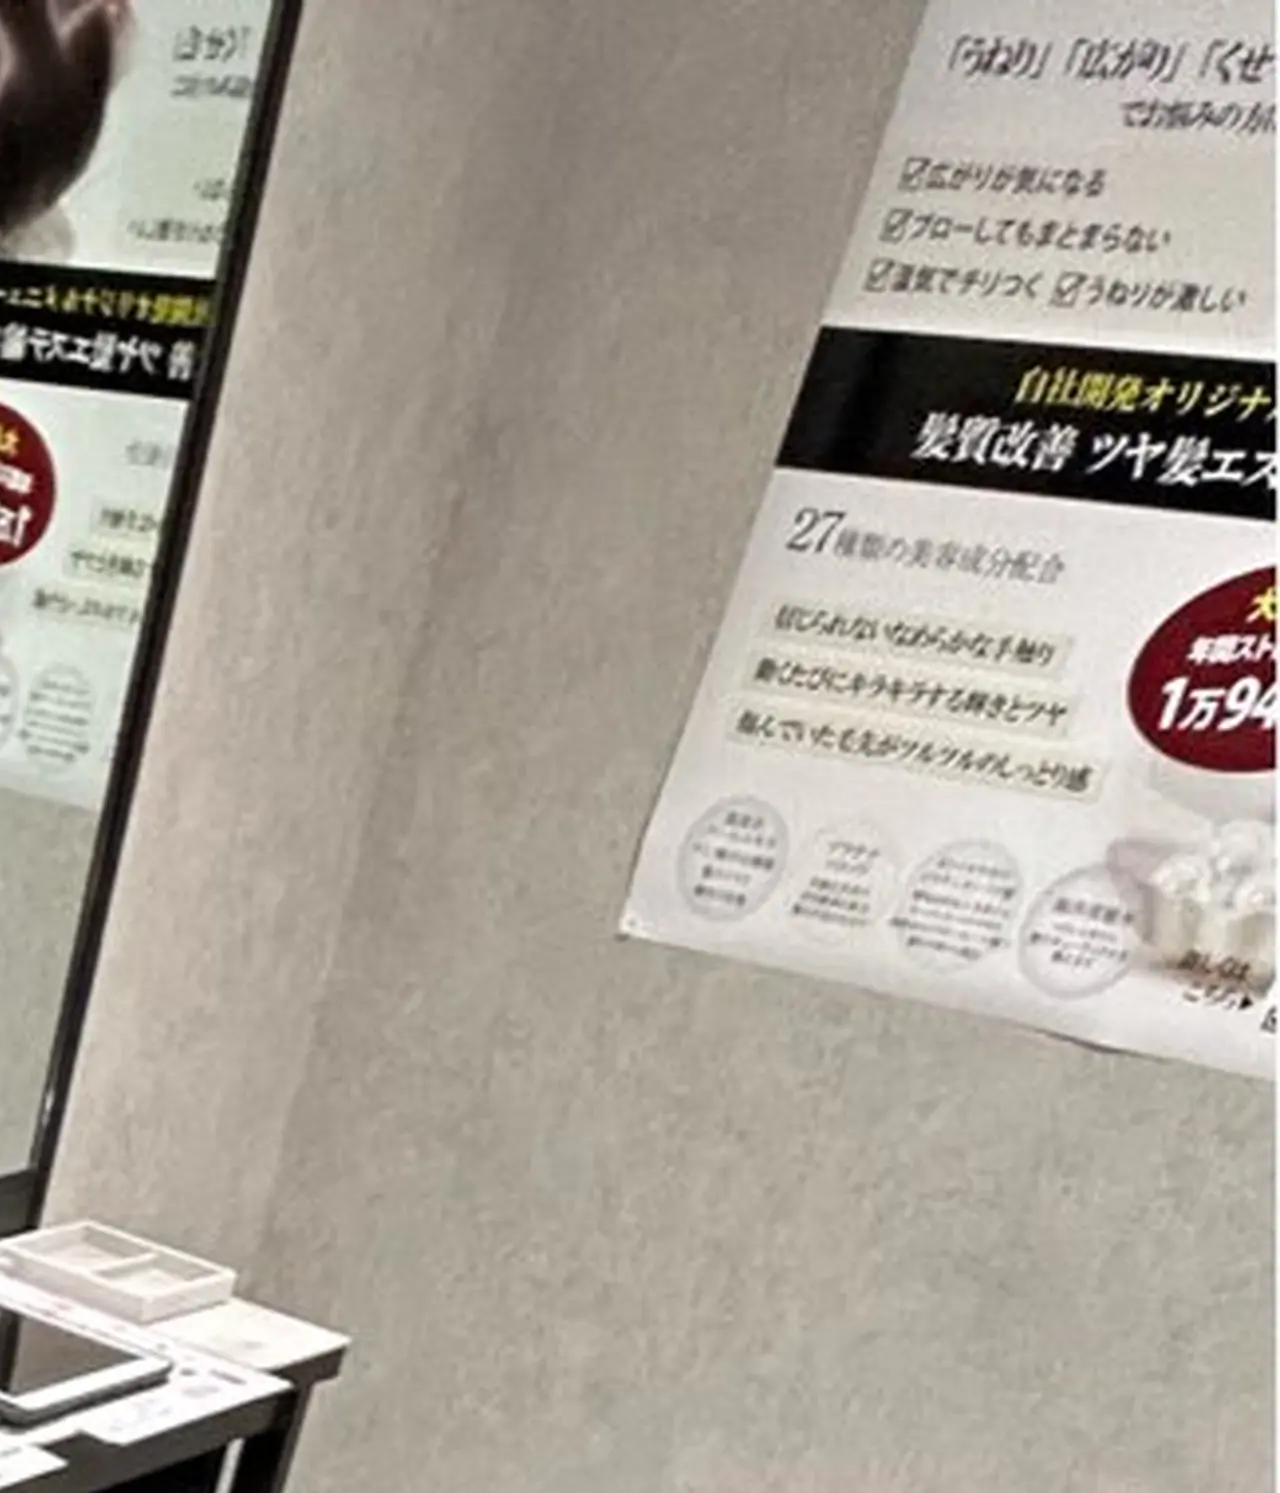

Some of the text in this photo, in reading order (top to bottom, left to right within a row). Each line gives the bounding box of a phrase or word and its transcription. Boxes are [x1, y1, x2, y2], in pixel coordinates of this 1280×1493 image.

[912, 214, 1172, 254] ブローしてもまとまらない
[1014, 365, 1276, 422] 自社開発オリジナ
[909, 411, 1082, 473] 髪質改善
